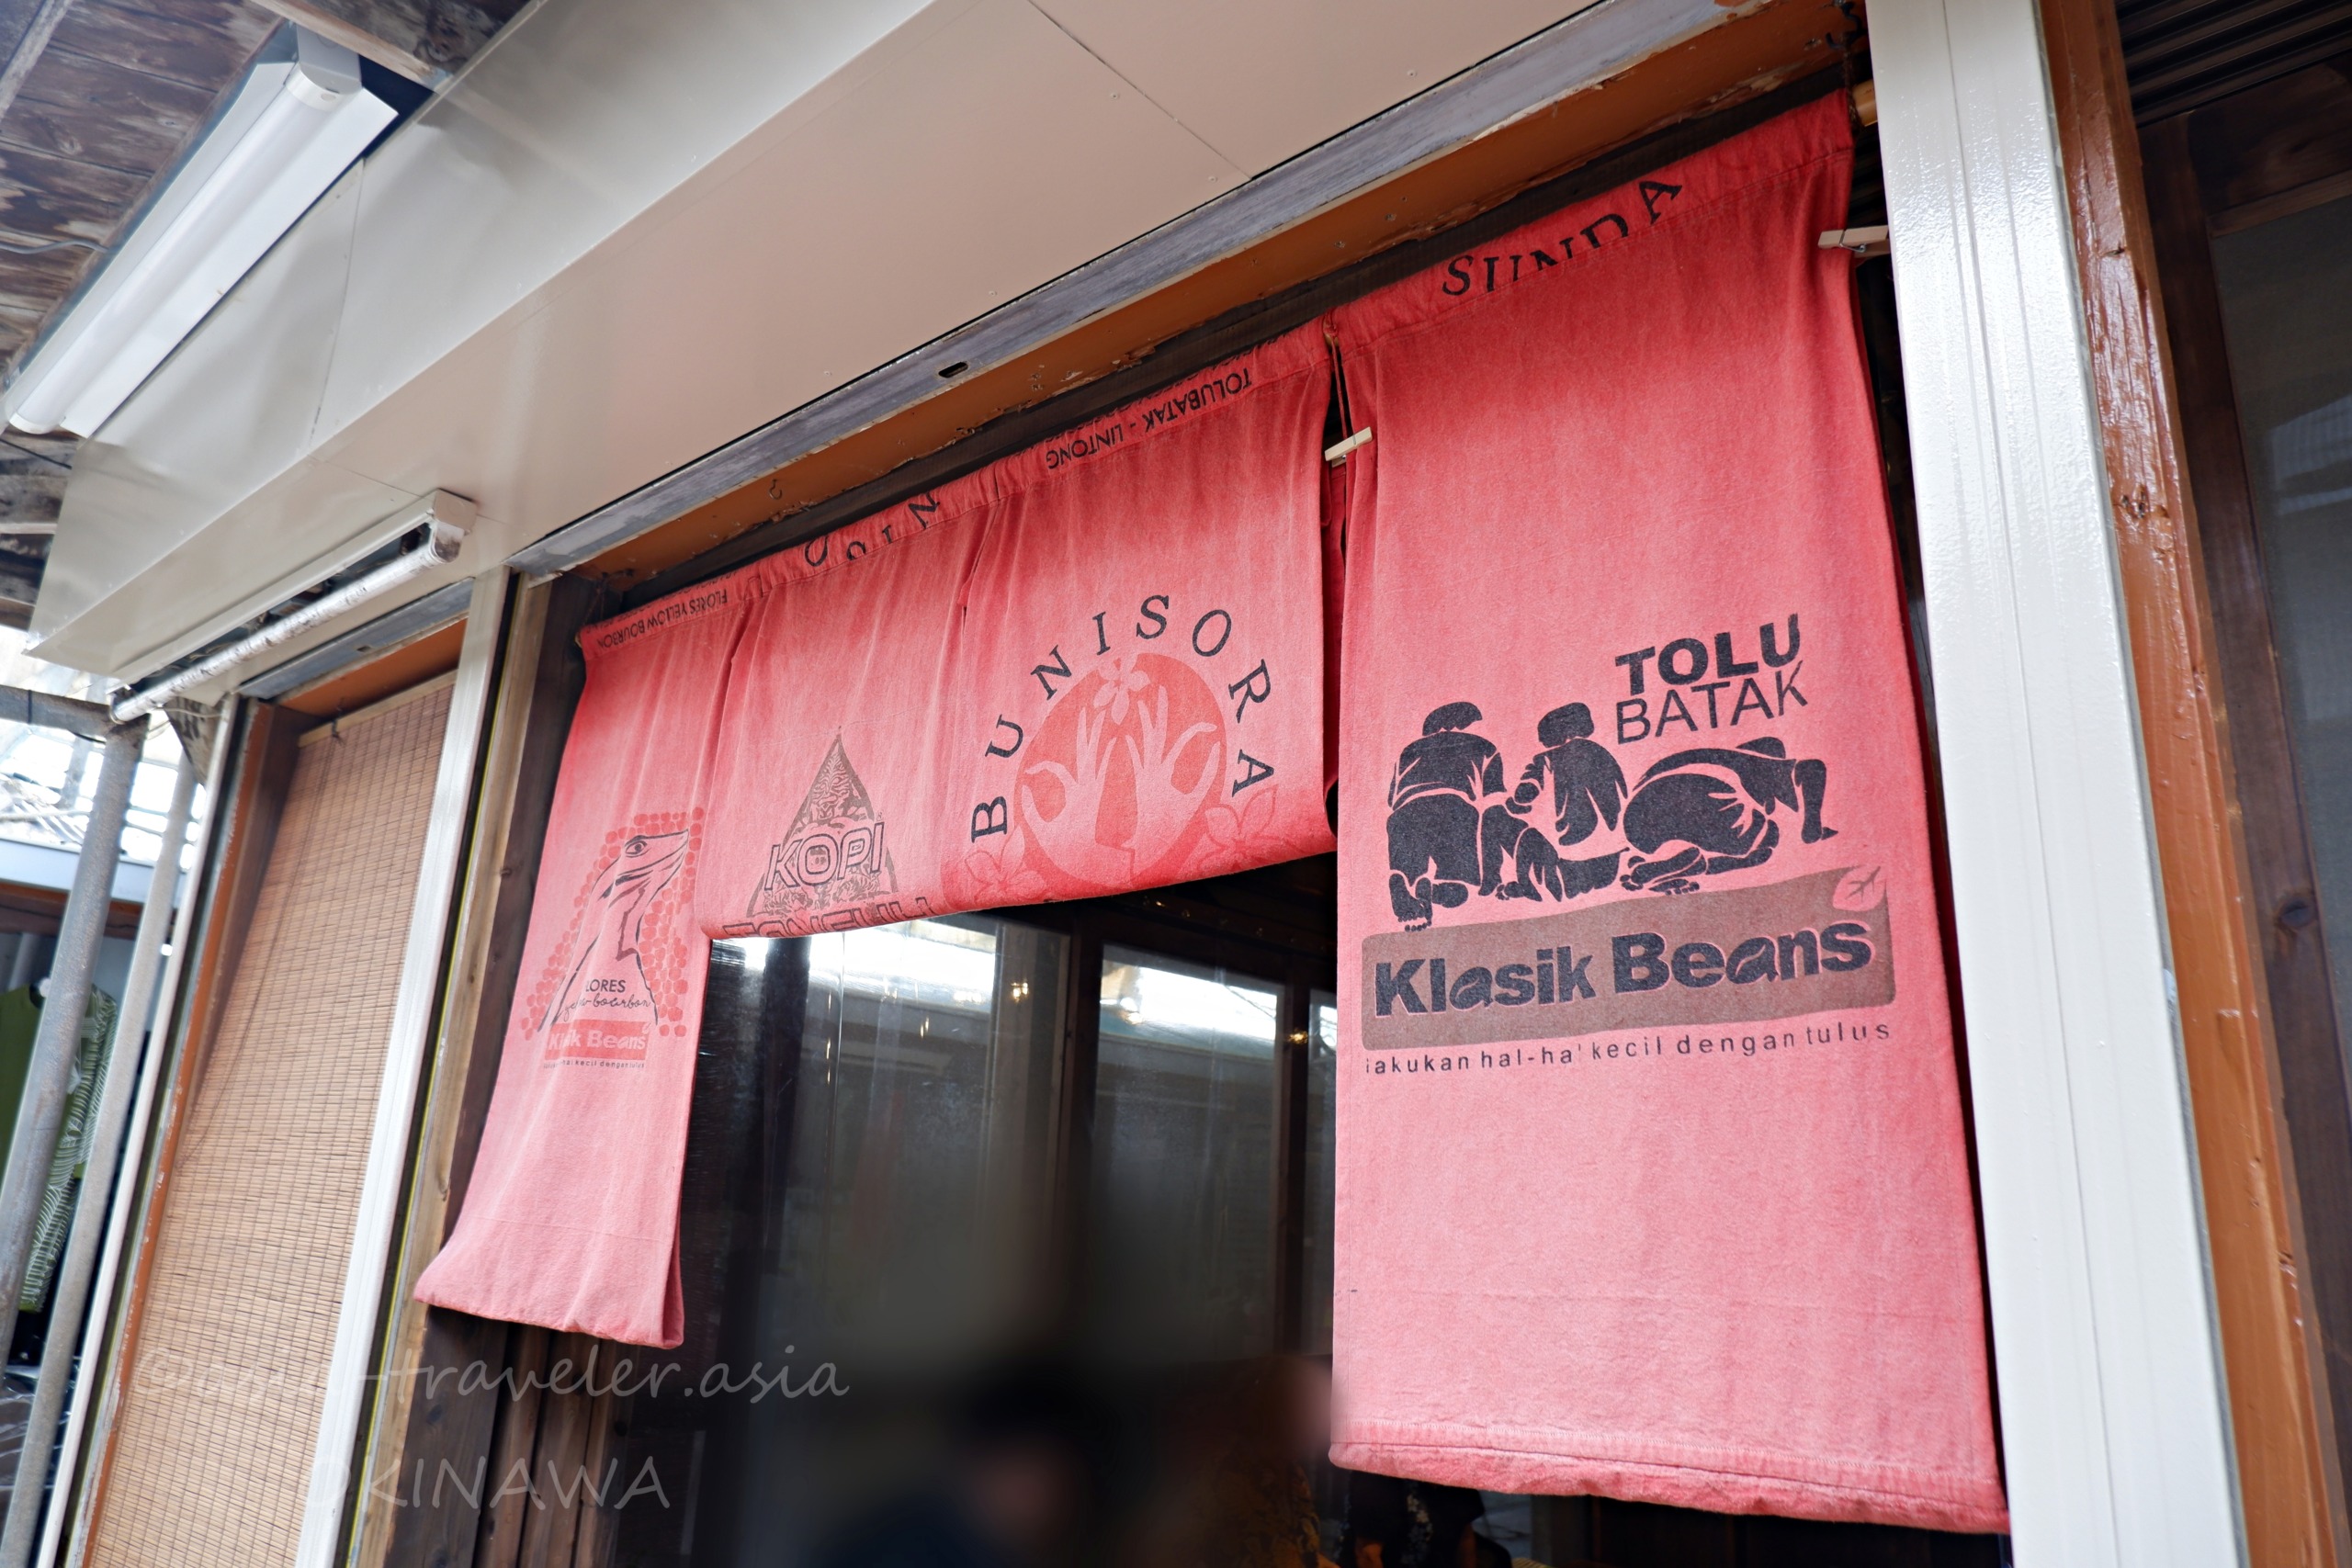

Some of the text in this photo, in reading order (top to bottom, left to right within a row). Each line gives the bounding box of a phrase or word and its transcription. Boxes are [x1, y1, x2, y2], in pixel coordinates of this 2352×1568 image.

[1142, 367, 1253, 433] TOLUBATAK
[1045, 423, 1125, 469] LINTONG
[647, 603, 687, 631] YELLOW
[690, 589, 728, 615] FLORES
[1614, 613, 1801, 696] TOLU
[970, 593, 1275, 844] BUNISORA
[1615, 660, 1808, 745] BATAK
[763, 821, 885, 891] KOPI
[1374, 921, 1871, 1017] Klasik Beans
[587, 1030, 646, 1050] Beans
[1592, 1035, 1661, 1060] kecil
[1677, 1031, 1795, 1055] dengan
[1806, 1021, 1890, 1045] tulus
